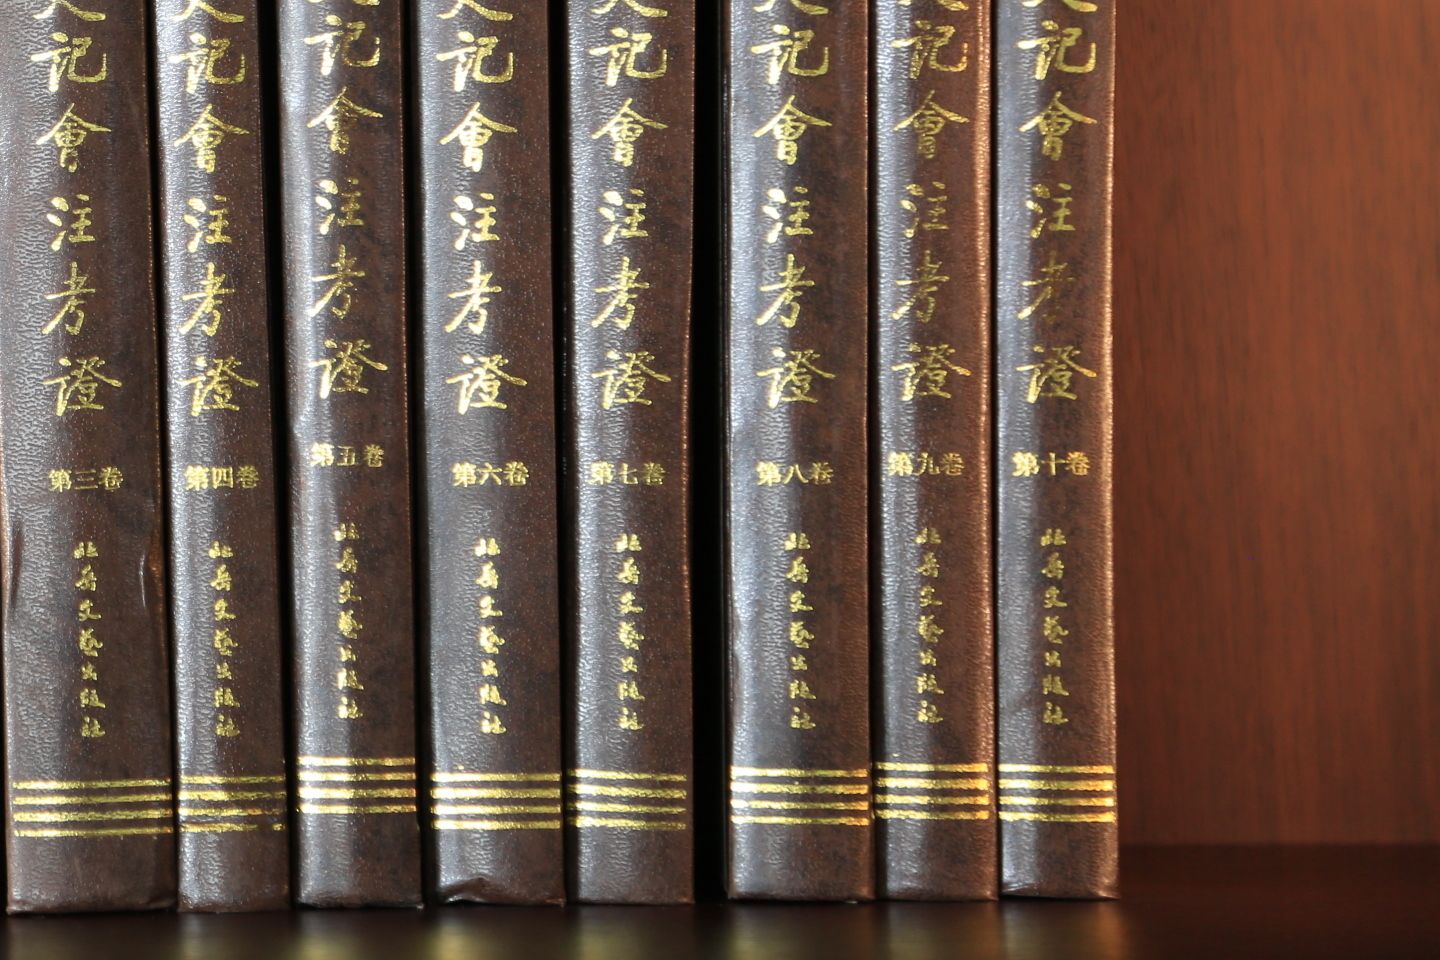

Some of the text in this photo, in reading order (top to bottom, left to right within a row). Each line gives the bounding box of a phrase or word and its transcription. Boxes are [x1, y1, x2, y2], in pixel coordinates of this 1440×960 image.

[310, 442, 383, 468] 第五卷
[888, 452, 965, 478] 第九卷
[1012, 452, 1091, 478] 第十卷
[48, 467, 123, 492] 第三卷
[184, 465, 259, 491] 第四卷
[452, 461, 529, 487] 第六卷
[590, 461, 666, 487] 第七卷
[755, 461, 832, 487] 第八卷
